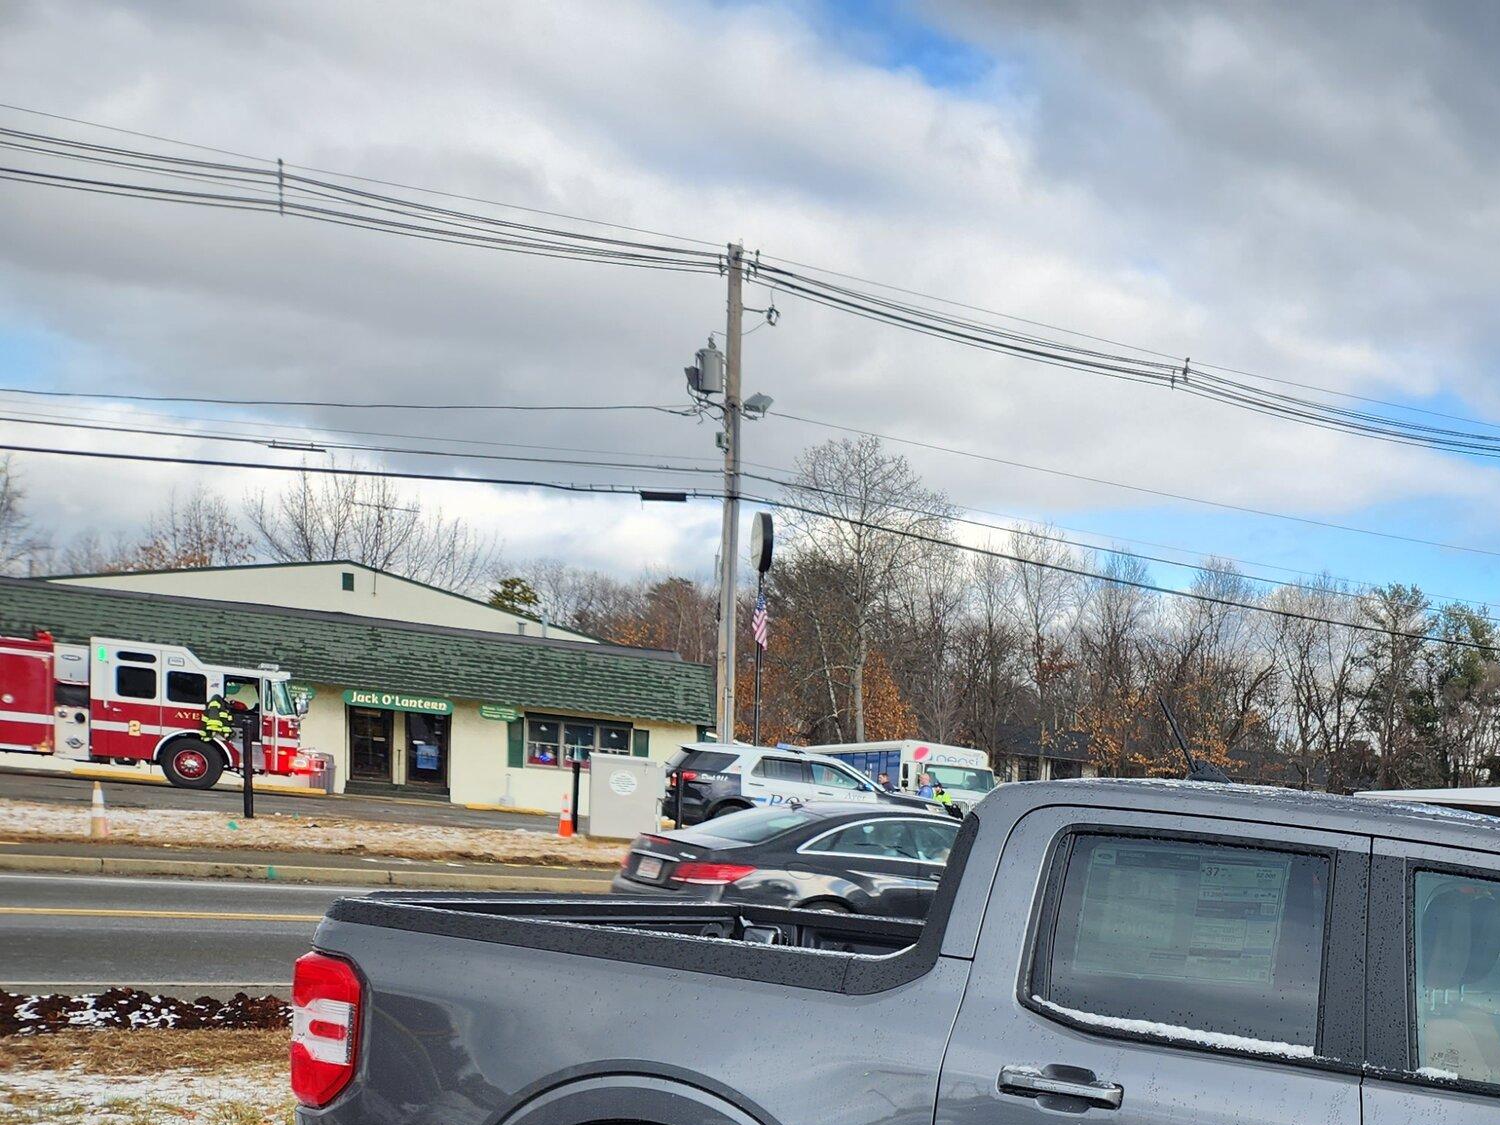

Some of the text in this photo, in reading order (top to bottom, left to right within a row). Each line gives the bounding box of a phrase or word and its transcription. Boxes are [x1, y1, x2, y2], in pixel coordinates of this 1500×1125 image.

[351, 692, 447, 711] Jack O'Lantern
[175, 711, 202, 720] AYE
[129, 720, 141, 736] 2
